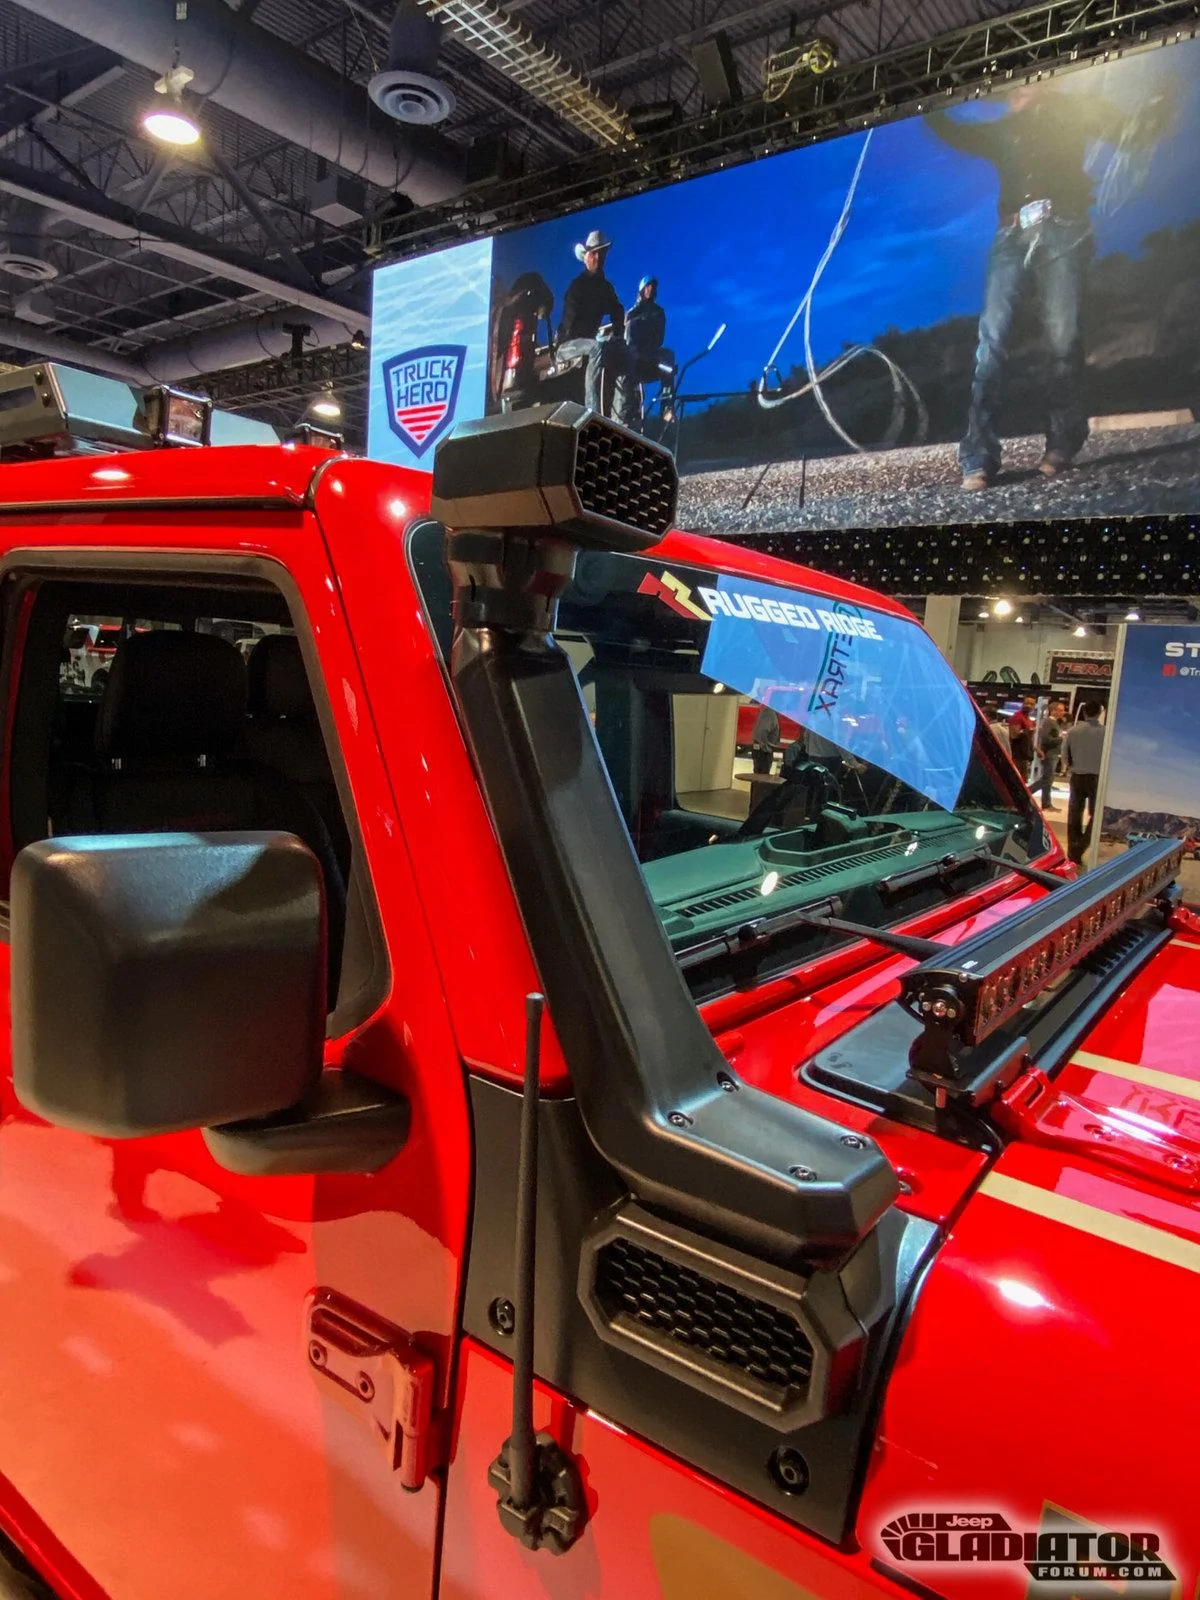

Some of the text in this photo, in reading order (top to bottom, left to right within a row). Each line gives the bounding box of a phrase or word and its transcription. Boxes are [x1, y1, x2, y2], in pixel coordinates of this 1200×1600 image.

[393, 360, 454, 388] TRUCK
[397, 381, 447, 408] HERO
[697, 587, 884, 641] RUGGED RIDGE
[1056, 662, 1112, 677] TERA
